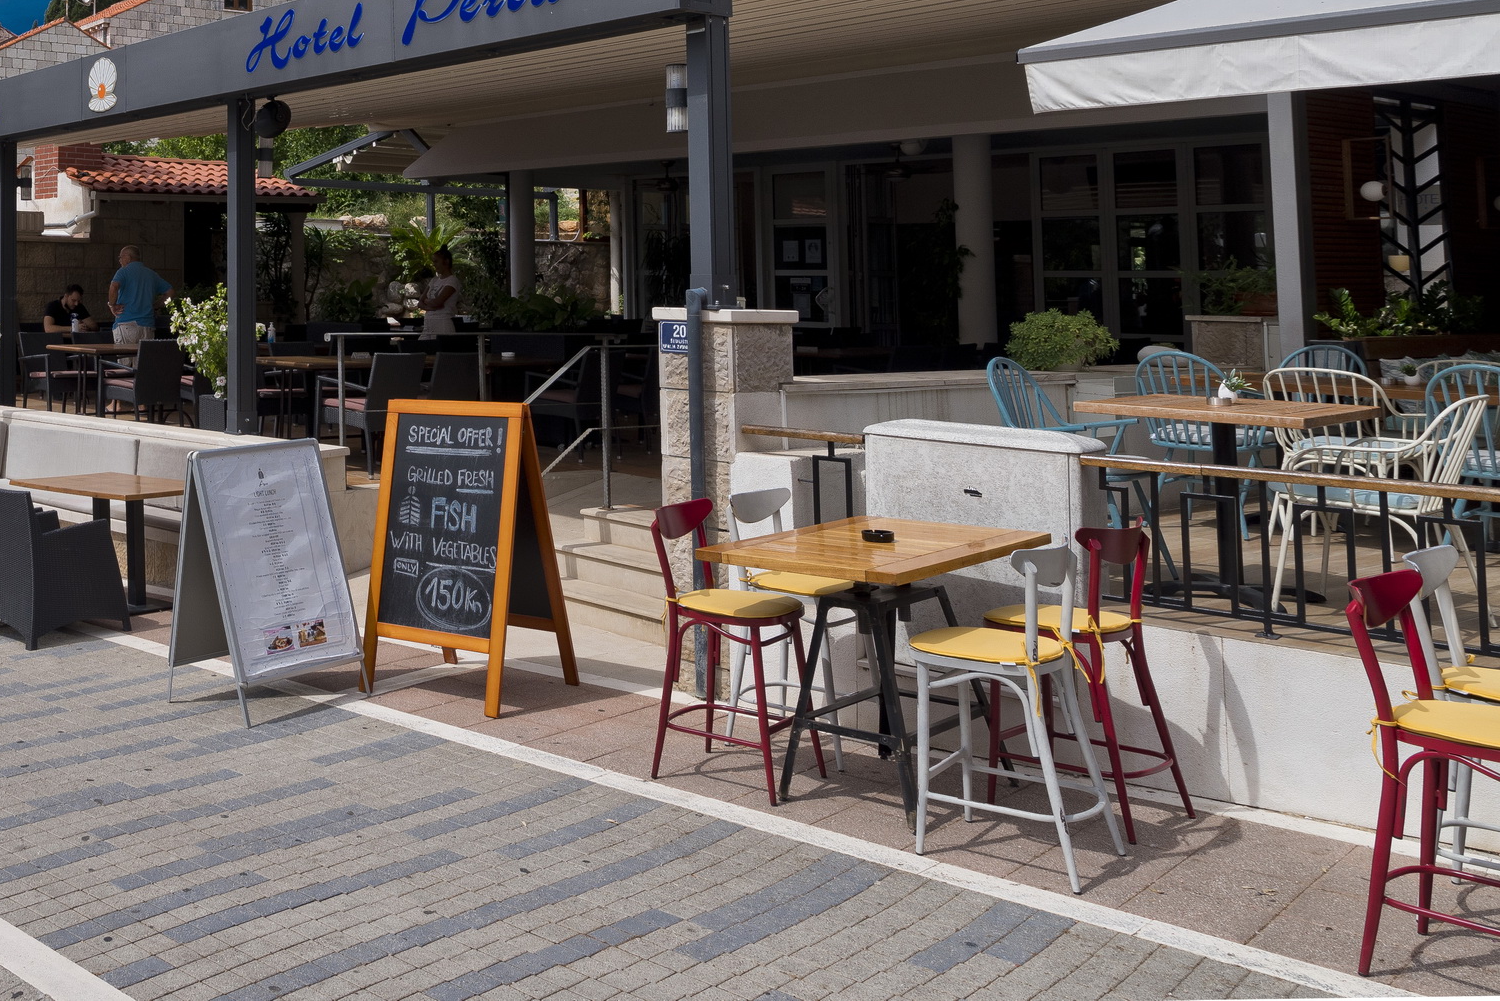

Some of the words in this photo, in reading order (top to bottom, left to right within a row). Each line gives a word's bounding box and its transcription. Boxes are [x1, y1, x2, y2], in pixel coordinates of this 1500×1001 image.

[246, 2, 365, 73] Hotel
[672, 324, 687, 338] 20
[457, 427, 493, 447] OFFER
[457, 469, 494, 489] FRESH
[432, 536, 497, 569] VEGETABLES
